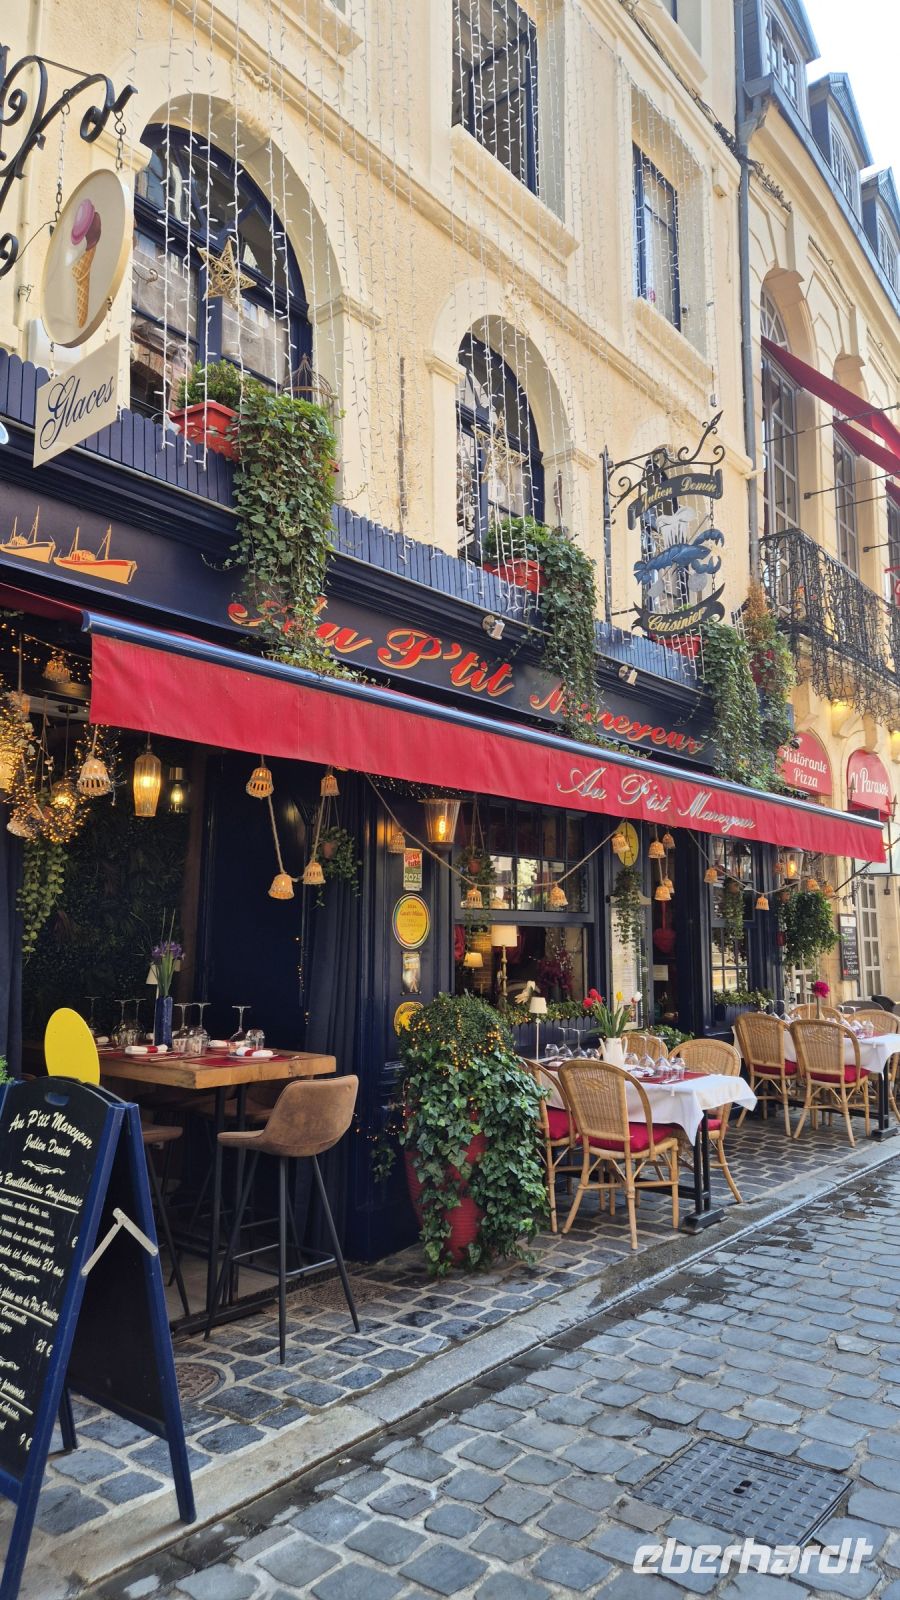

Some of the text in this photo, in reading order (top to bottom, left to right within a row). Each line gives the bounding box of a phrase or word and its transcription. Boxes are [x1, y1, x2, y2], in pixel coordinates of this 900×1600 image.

[38, 375, 115, 450] Glaces
[680, 475, 718, 494] Domin
[648, 606, 708, 632] Cuisinier
[376, 628, 516, 698] P'tit
[782, 746, 828, 774] Ristorante
[793, 766, 819, 788] Pizza
[556, 767, 757, 832] Au P'tit Mareyeur
[9, 1109, 93, 1150] Au P'tit Mareyeur
[22, 1134, 72, 1158] Julien Domin
[4, 1173, 44, 1194] Bouillabaisse
[21, 1251, 42, 1267] depuis
[41, 1258, 54, 1272] 20
[53, 1266, 65, 1277] ans
[35, 1339, 54, 1358] 28 €
[25, 1437, 33, 1452] €
